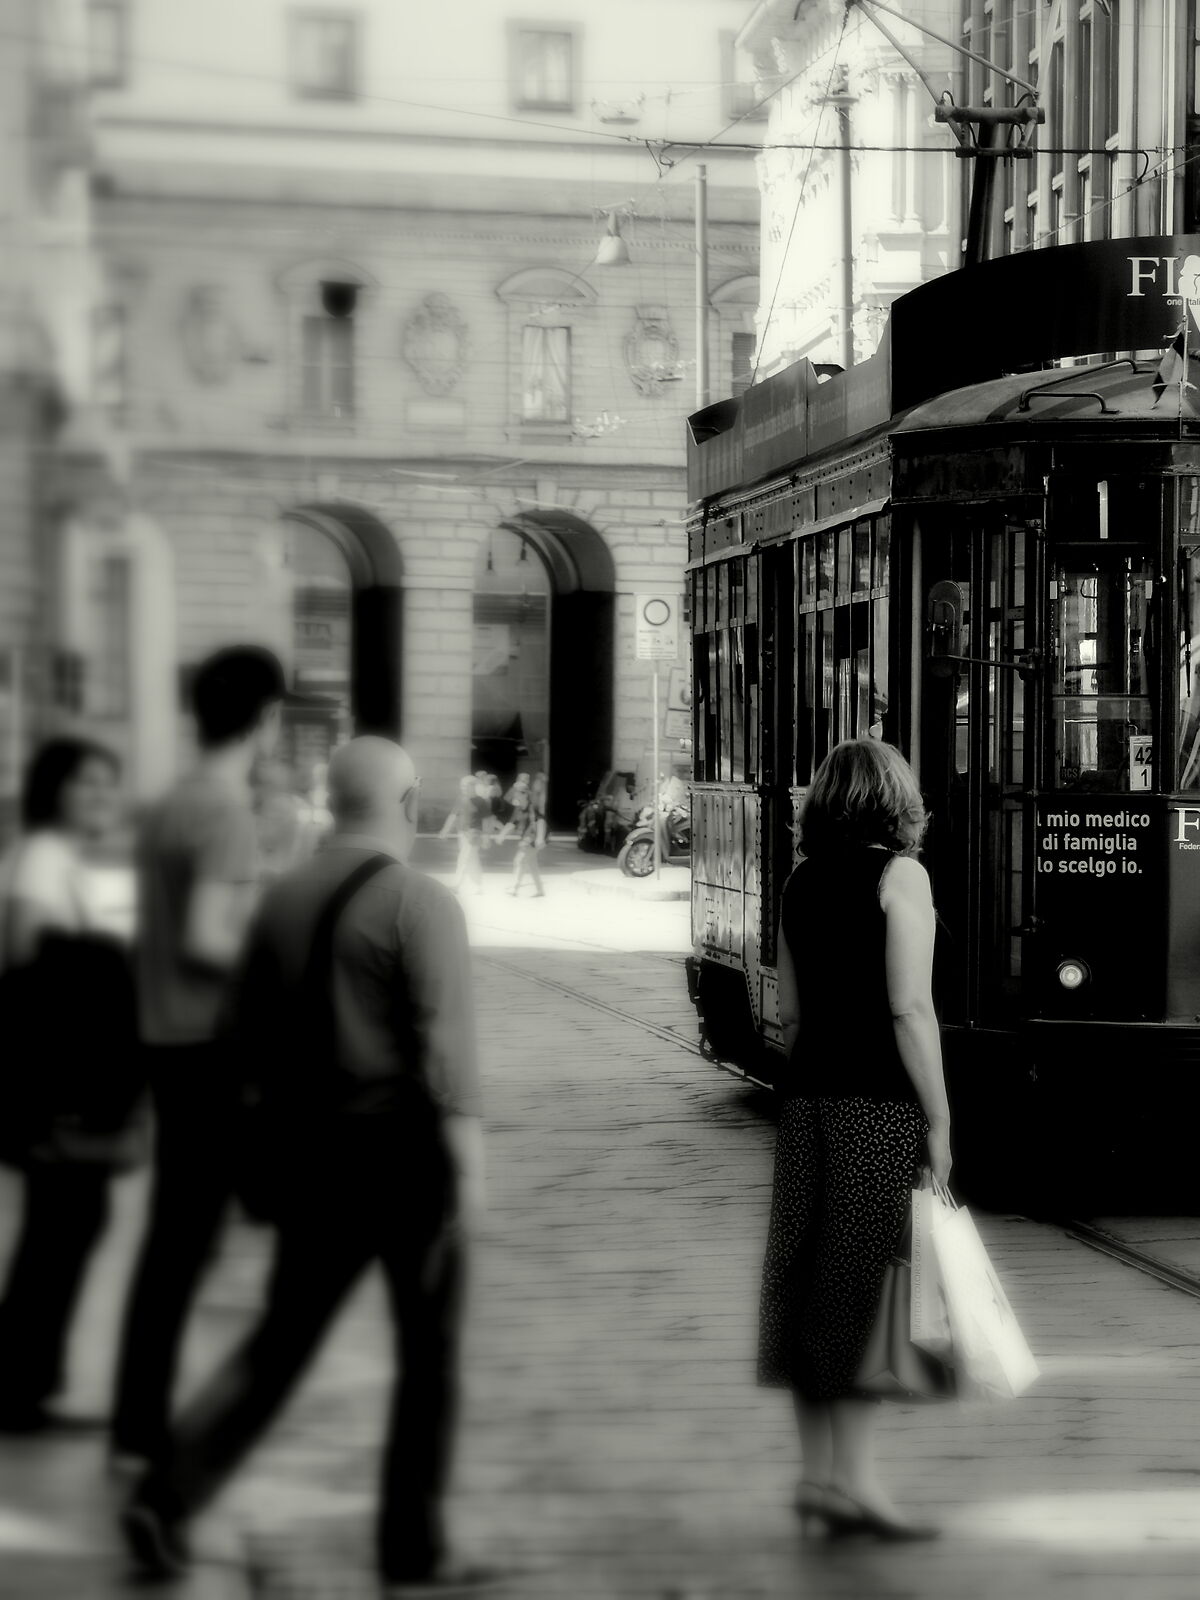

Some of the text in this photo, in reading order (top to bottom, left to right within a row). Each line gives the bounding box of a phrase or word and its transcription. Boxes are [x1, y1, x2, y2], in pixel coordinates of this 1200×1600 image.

[1097, 480, 1109, 539] 1
[1140, 768, 1148, 787] 1
[1047, 810, 1080, 827] mio
[1085, 810, 1150, 827] medico
[1042, 833, 1138, 854] di famiglia
[1037, 856, 1143, 878] lo scelgo io.
